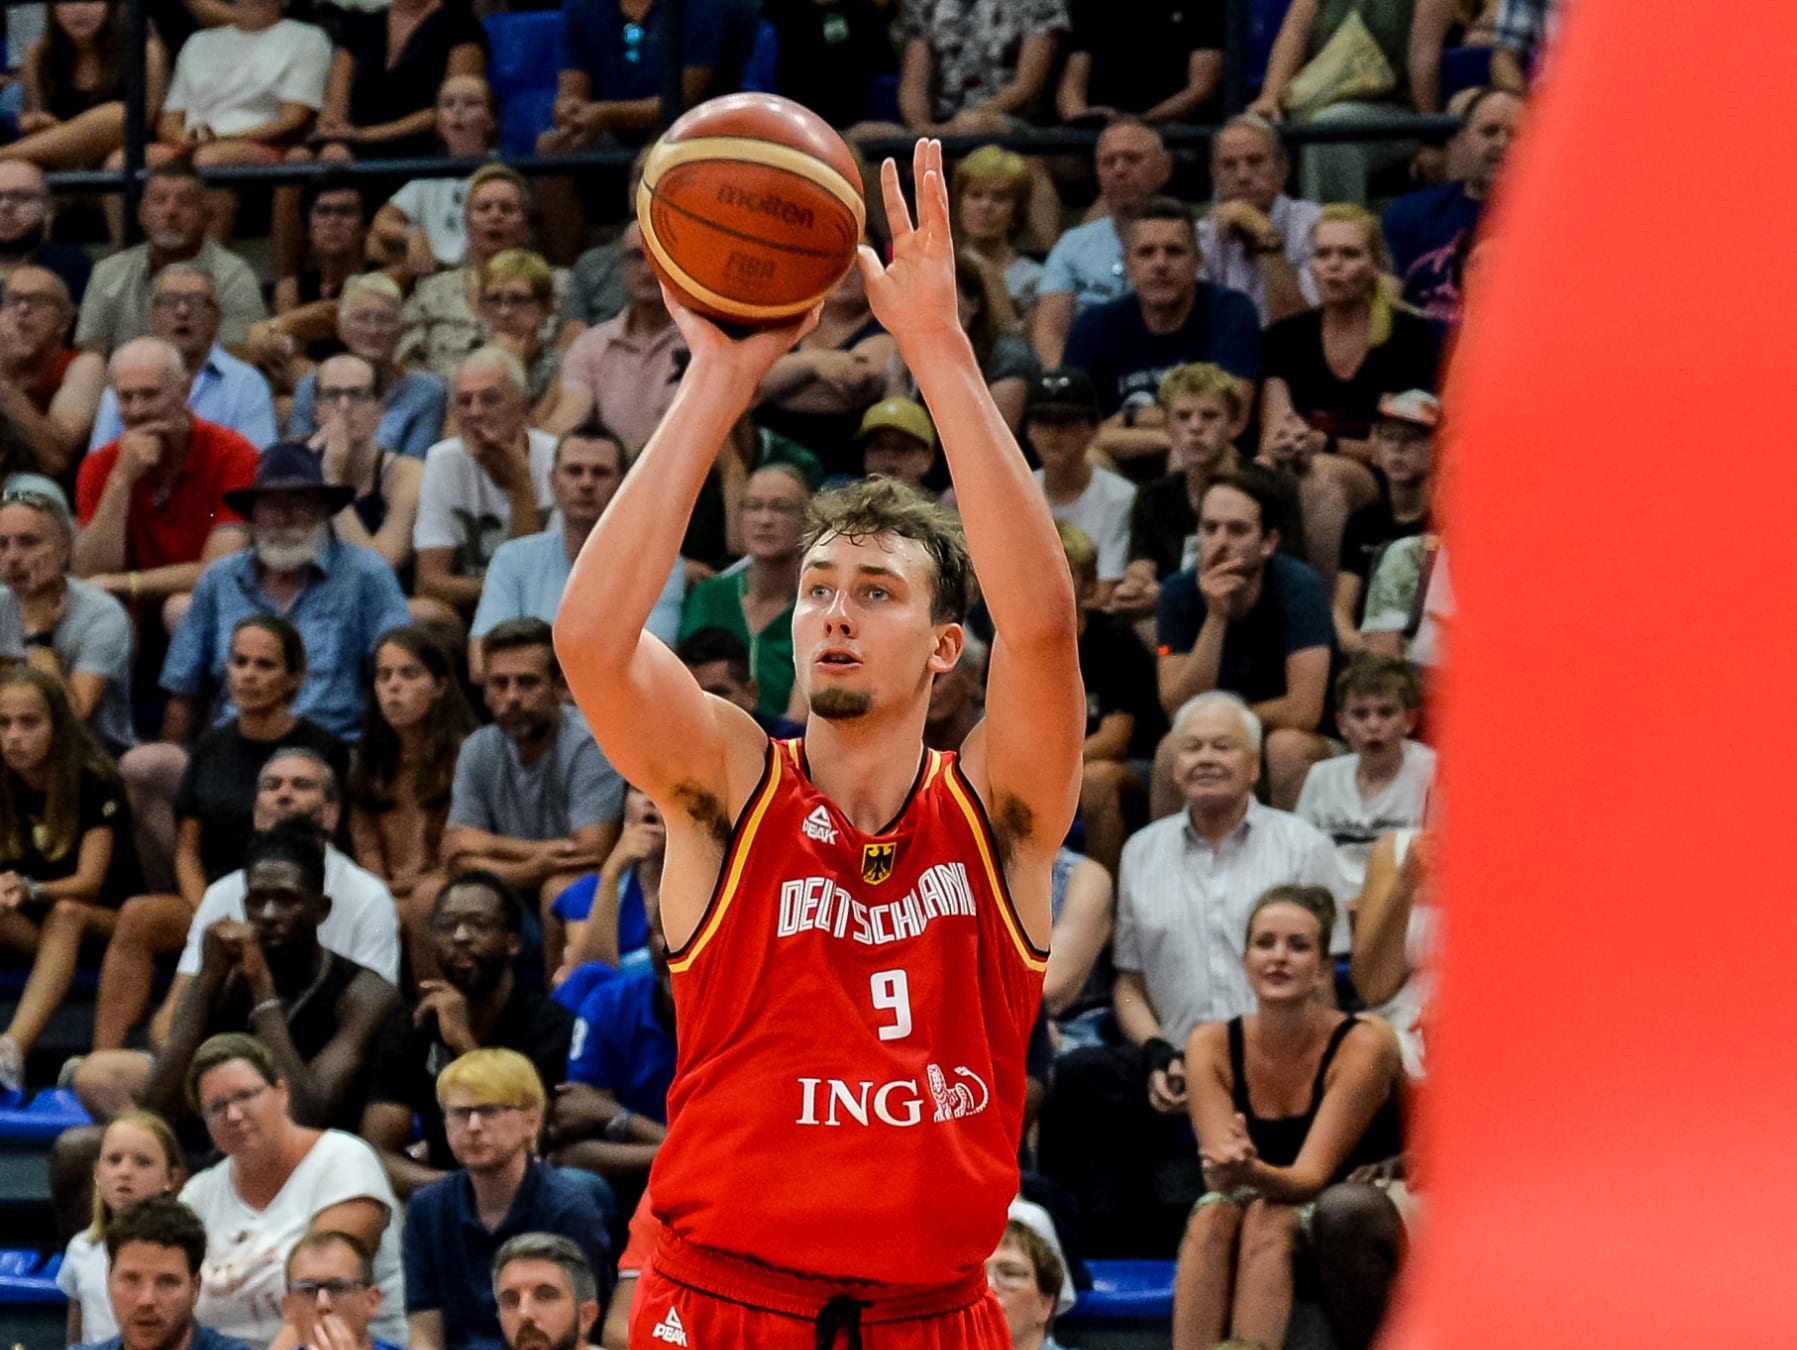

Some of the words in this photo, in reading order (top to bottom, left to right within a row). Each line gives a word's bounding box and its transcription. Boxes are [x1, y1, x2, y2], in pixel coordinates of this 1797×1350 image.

[717, 184, 815, 229] molten
[725, 250, 776, 279] FIBA
[801, 818, 839, 845] PEAK
[870, 969, 912, 1041] 9
[795, 1077, 924, 1127] ING
[652, 1321, 688, 1348] PEAK
